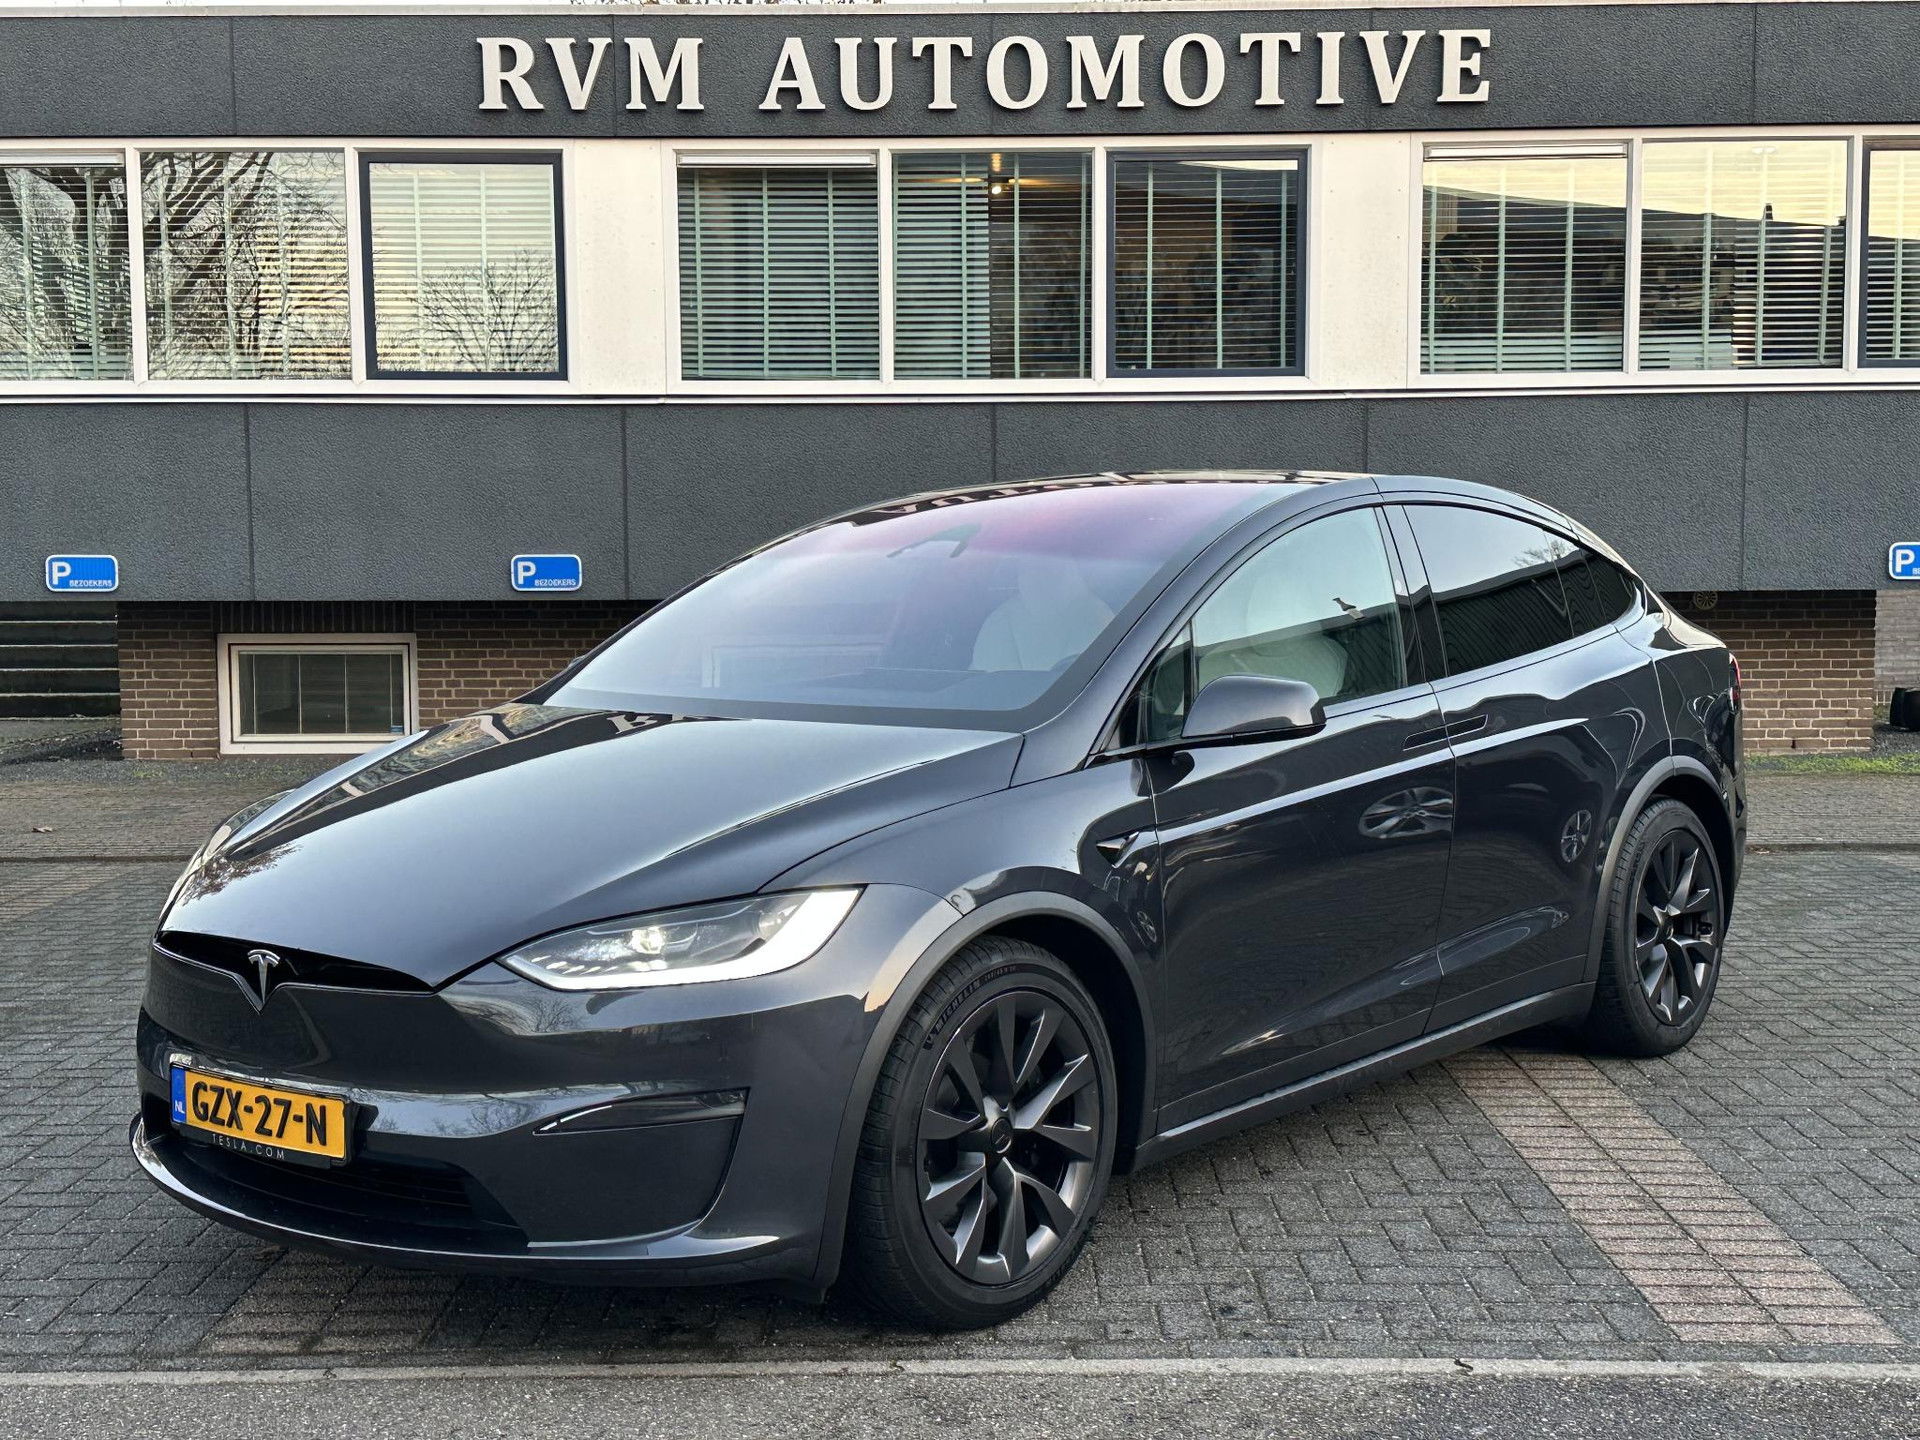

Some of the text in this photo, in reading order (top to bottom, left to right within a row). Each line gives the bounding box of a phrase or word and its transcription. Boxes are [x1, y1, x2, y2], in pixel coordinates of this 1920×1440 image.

[476, 28, 1492, 113] RVM AUTOMOTIVE
[52, 561, 112, 587] P BEZOEKERS
[517, 561, 576, 587] P BEZOEKERS
[1895, 549, 1915, 573] P
[174, 1101, 186, 1115] NL
[192, 1081, 327, 1146] GZX-27-N
[211, 1133, 285, 1160] TESLA.COM
